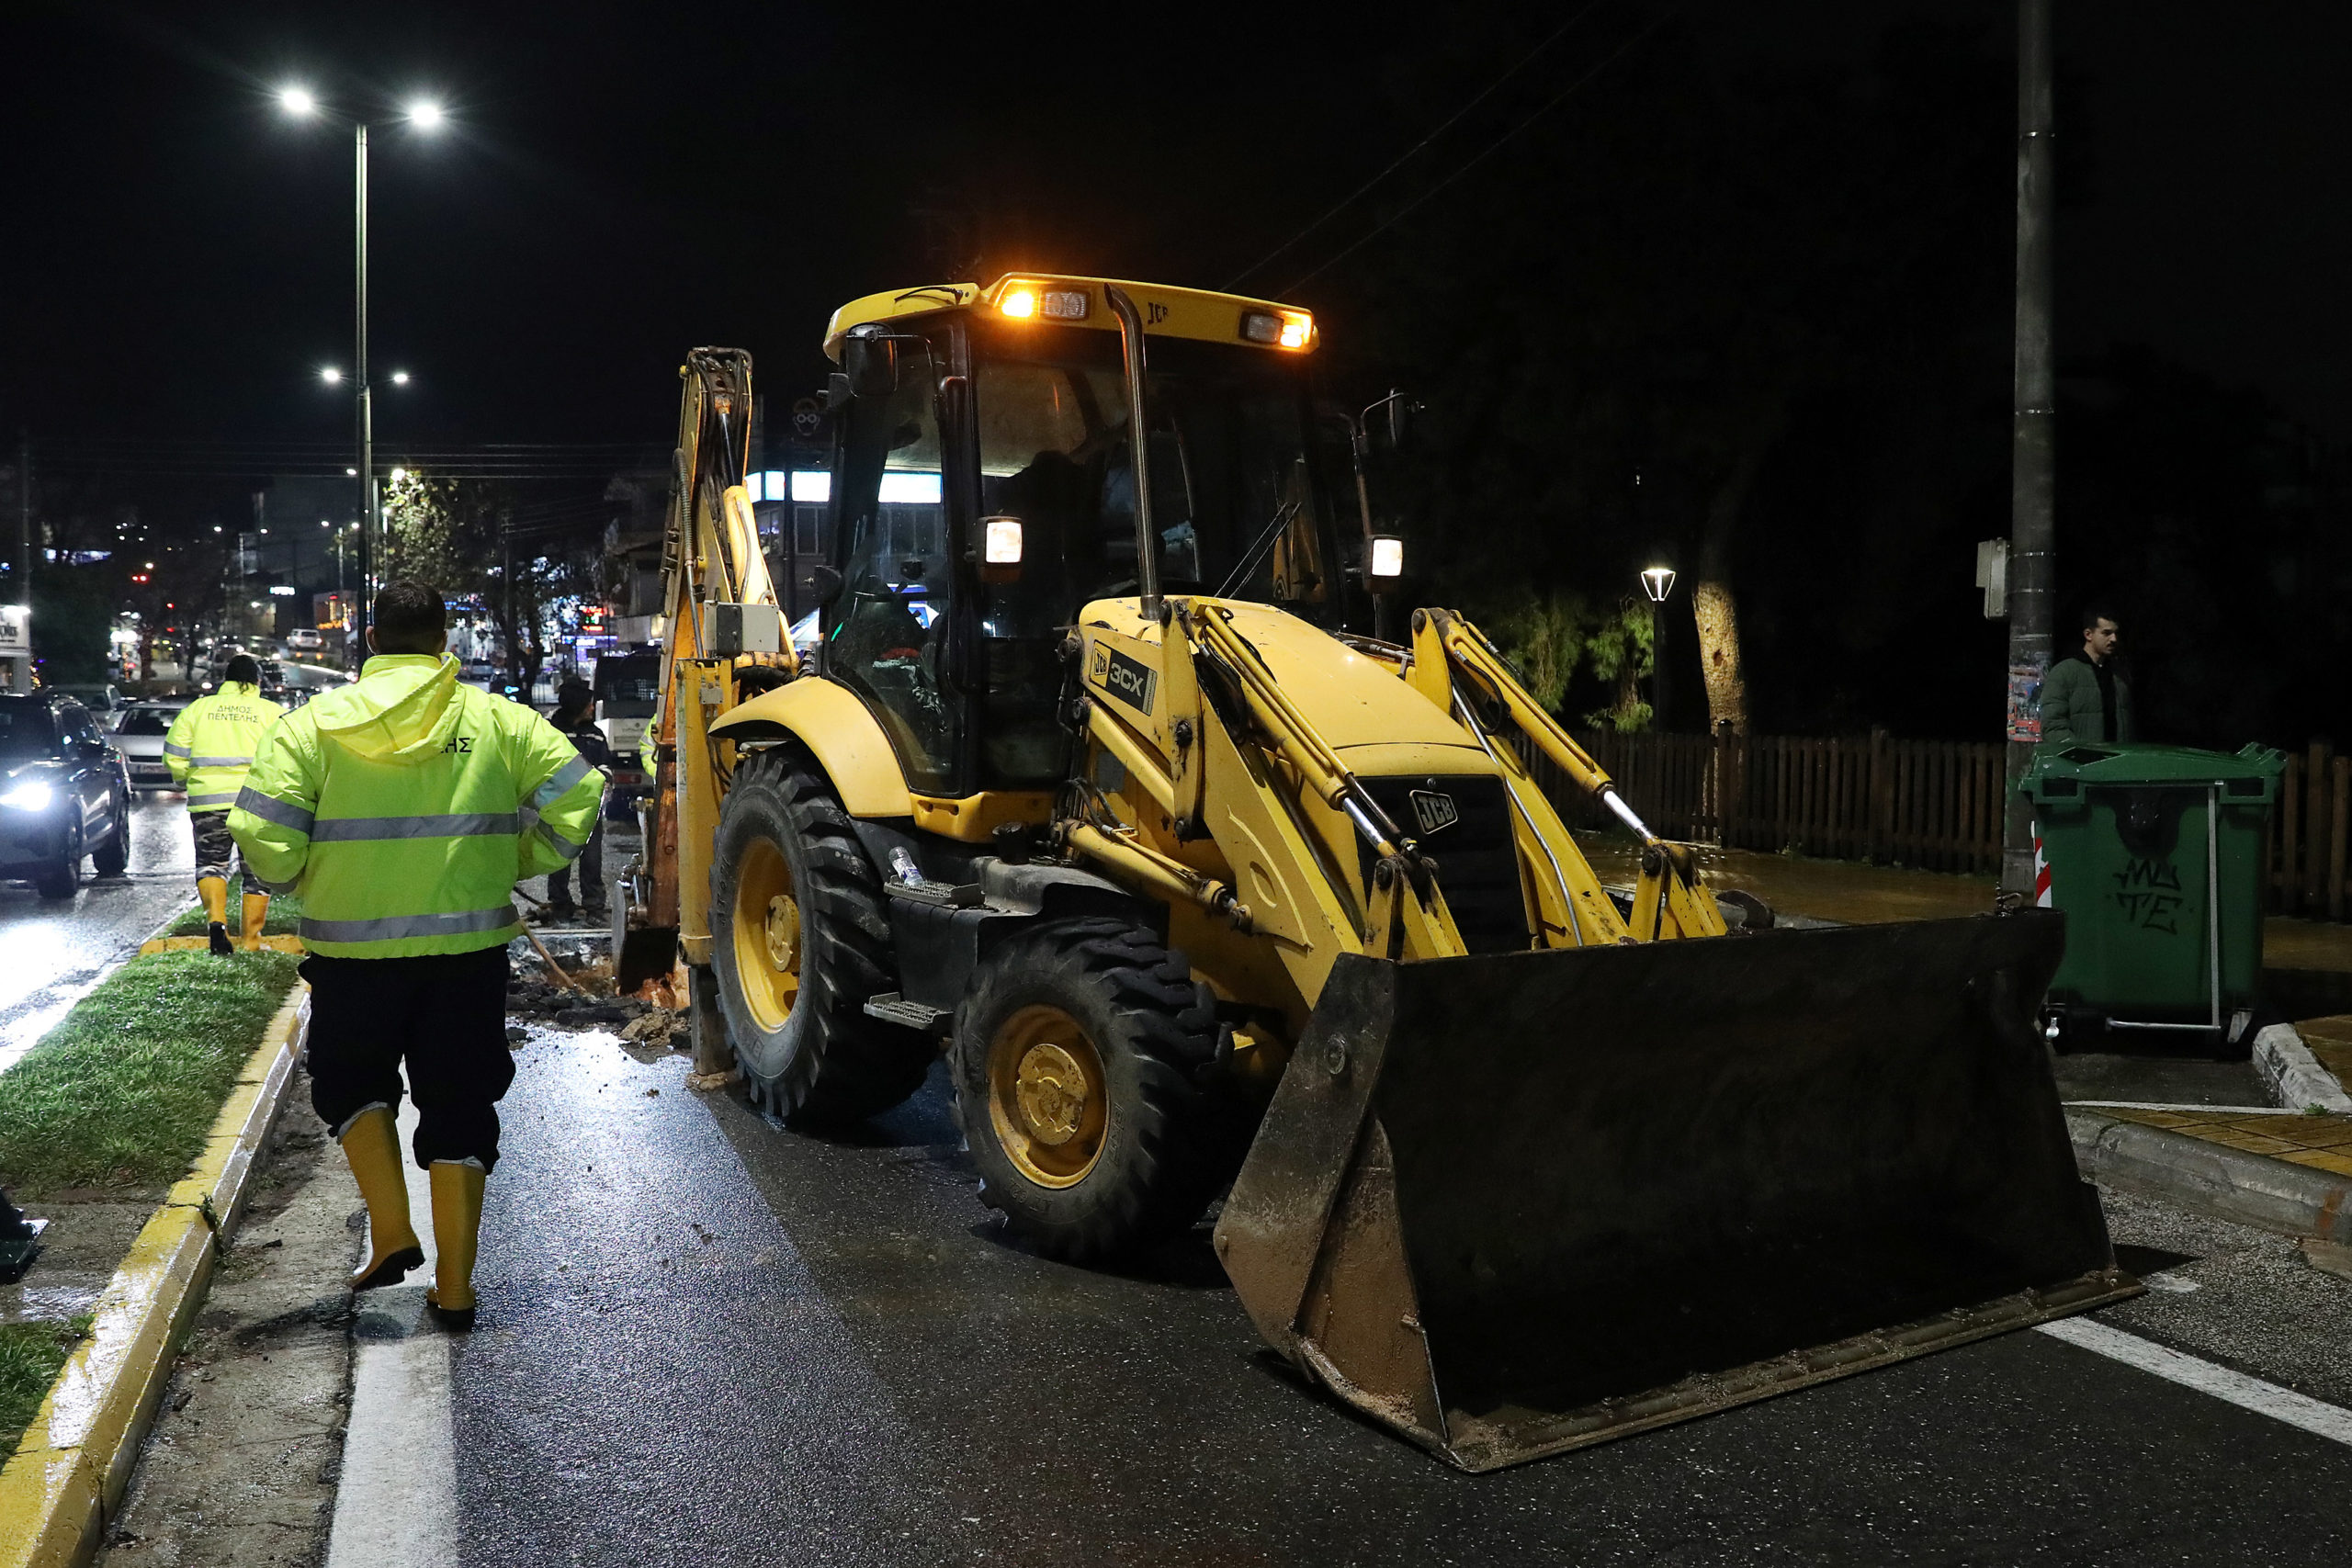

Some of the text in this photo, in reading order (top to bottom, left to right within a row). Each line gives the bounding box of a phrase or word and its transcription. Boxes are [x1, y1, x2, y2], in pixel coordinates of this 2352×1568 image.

[1094, 652, 1107, 673] JCB
[1109, 662, 1144, 697] 3CX
[208, 713, 258, 723] ΠΕΝΤΕΛΗΣ
[217, 705, 254, 714] ΔΗΜΟΣ
[441, 738, 472, 753] ΗΣ
[1418, 795, 1454, 829] JCB
